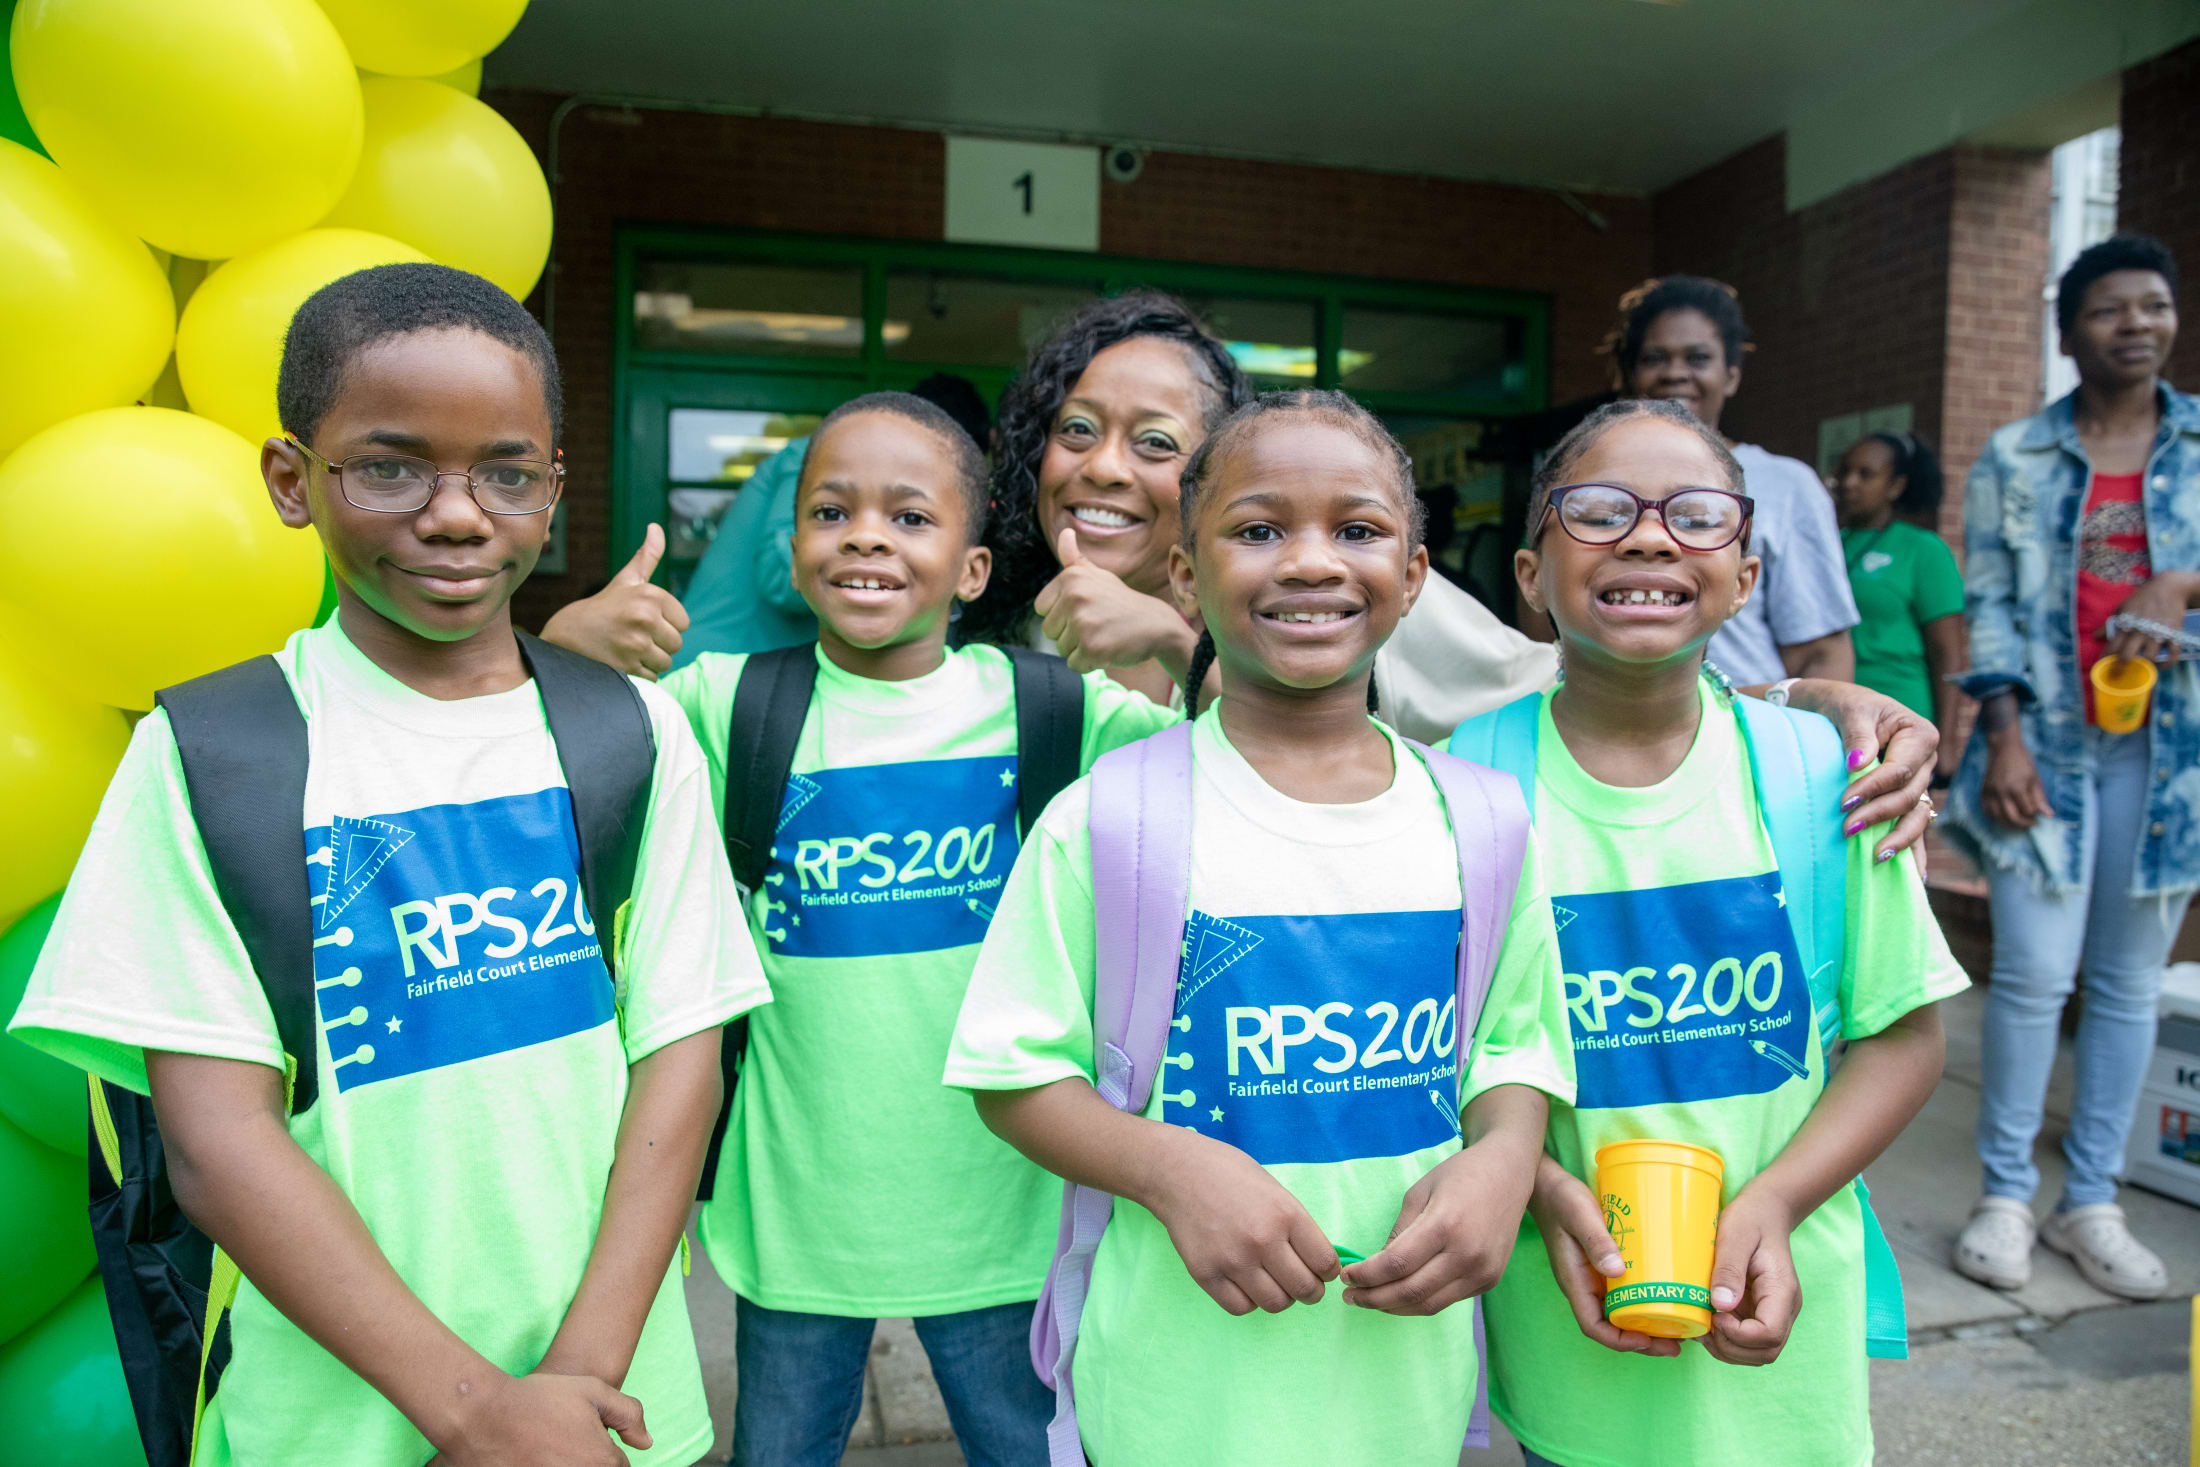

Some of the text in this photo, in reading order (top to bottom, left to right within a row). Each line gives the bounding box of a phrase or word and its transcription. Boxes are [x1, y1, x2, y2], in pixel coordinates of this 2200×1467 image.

[1012, 170, 1033, 216] 1
[794, 822, 997, 890] RPS200
[801, 874, 1002, 906] Fairfield Court Elementary School
[407, 970, 474, 1000] Fairfield
[477, 960, 527, 983] Court
[1564, 951, 1783, 1032] RPS200
[1225, 993, 1456, 1076] RPS200
[1571, 1010, 1792, 1051] irfield Court Elementary School
[1229, 1079, 1298, 1097] Fairfield
[1302, 1078, 1350, 1094] Court
[1353, 1071, 1430, 1092] Elementary
[1606, 1285, 1685, 1307] ELEMENTARY
